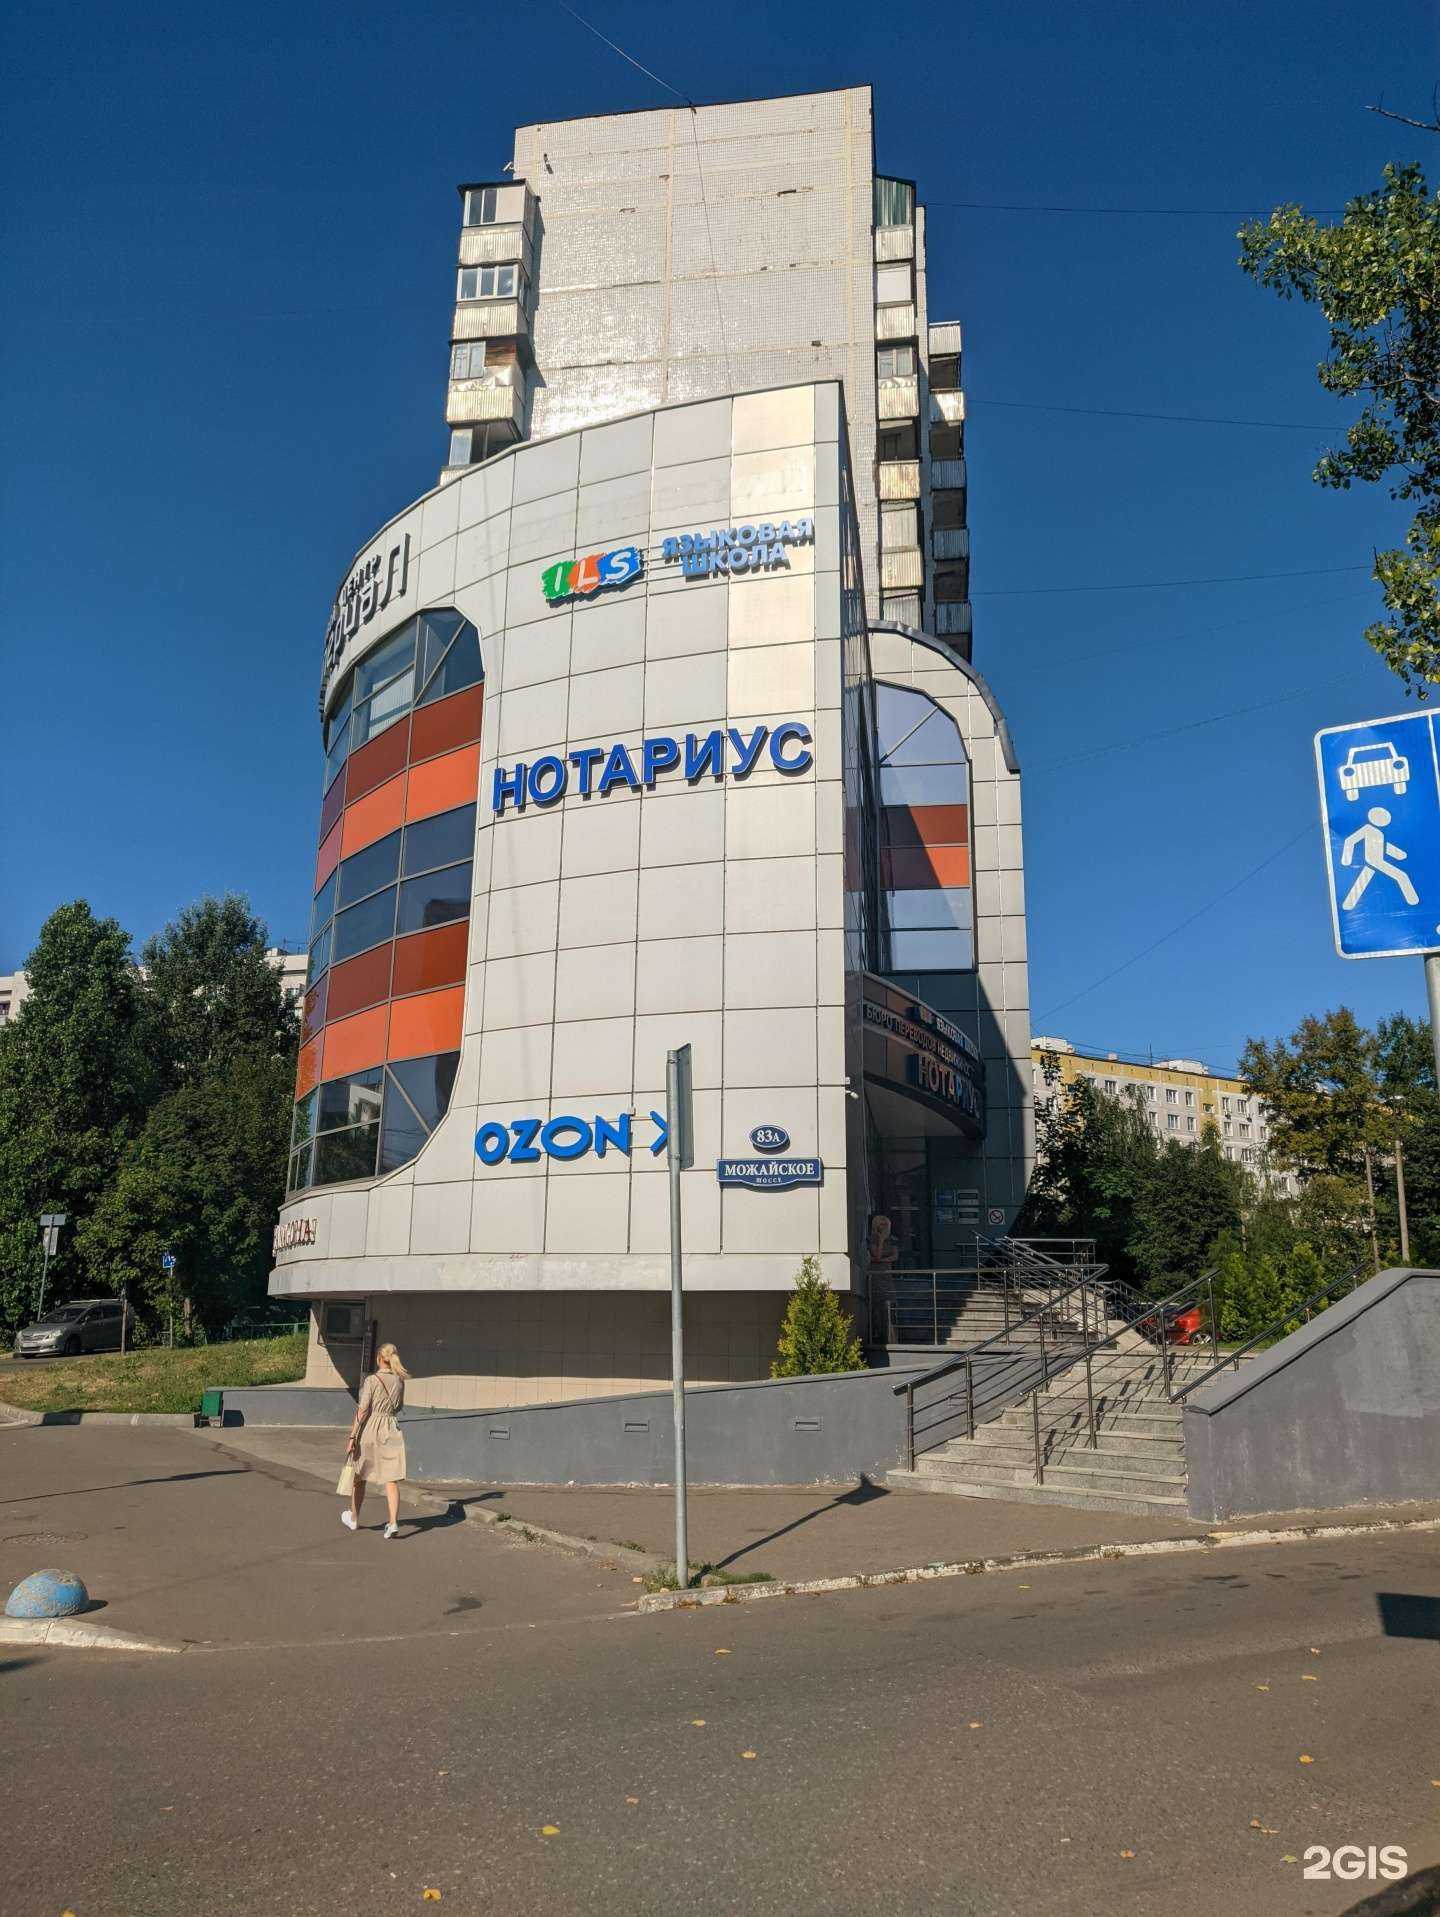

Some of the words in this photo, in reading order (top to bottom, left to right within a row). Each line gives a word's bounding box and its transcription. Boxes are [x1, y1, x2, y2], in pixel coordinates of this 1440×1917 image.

[662, 517, 813, 557] ЯЗЫКОВАЯ
[550, 549, 637, 595] ILS
[682, 541, 790, 581] ШКОЛА
[491, 721, 815, 814] НОТАРИУС
[866, 1007, 894, 1032] БЮРО
[474, 1112, 633, 1166] OZON
[756, 1128, 781, 1143] 83А
[724, 1161, 815, 1176] МОЖАЙСКОЕ
